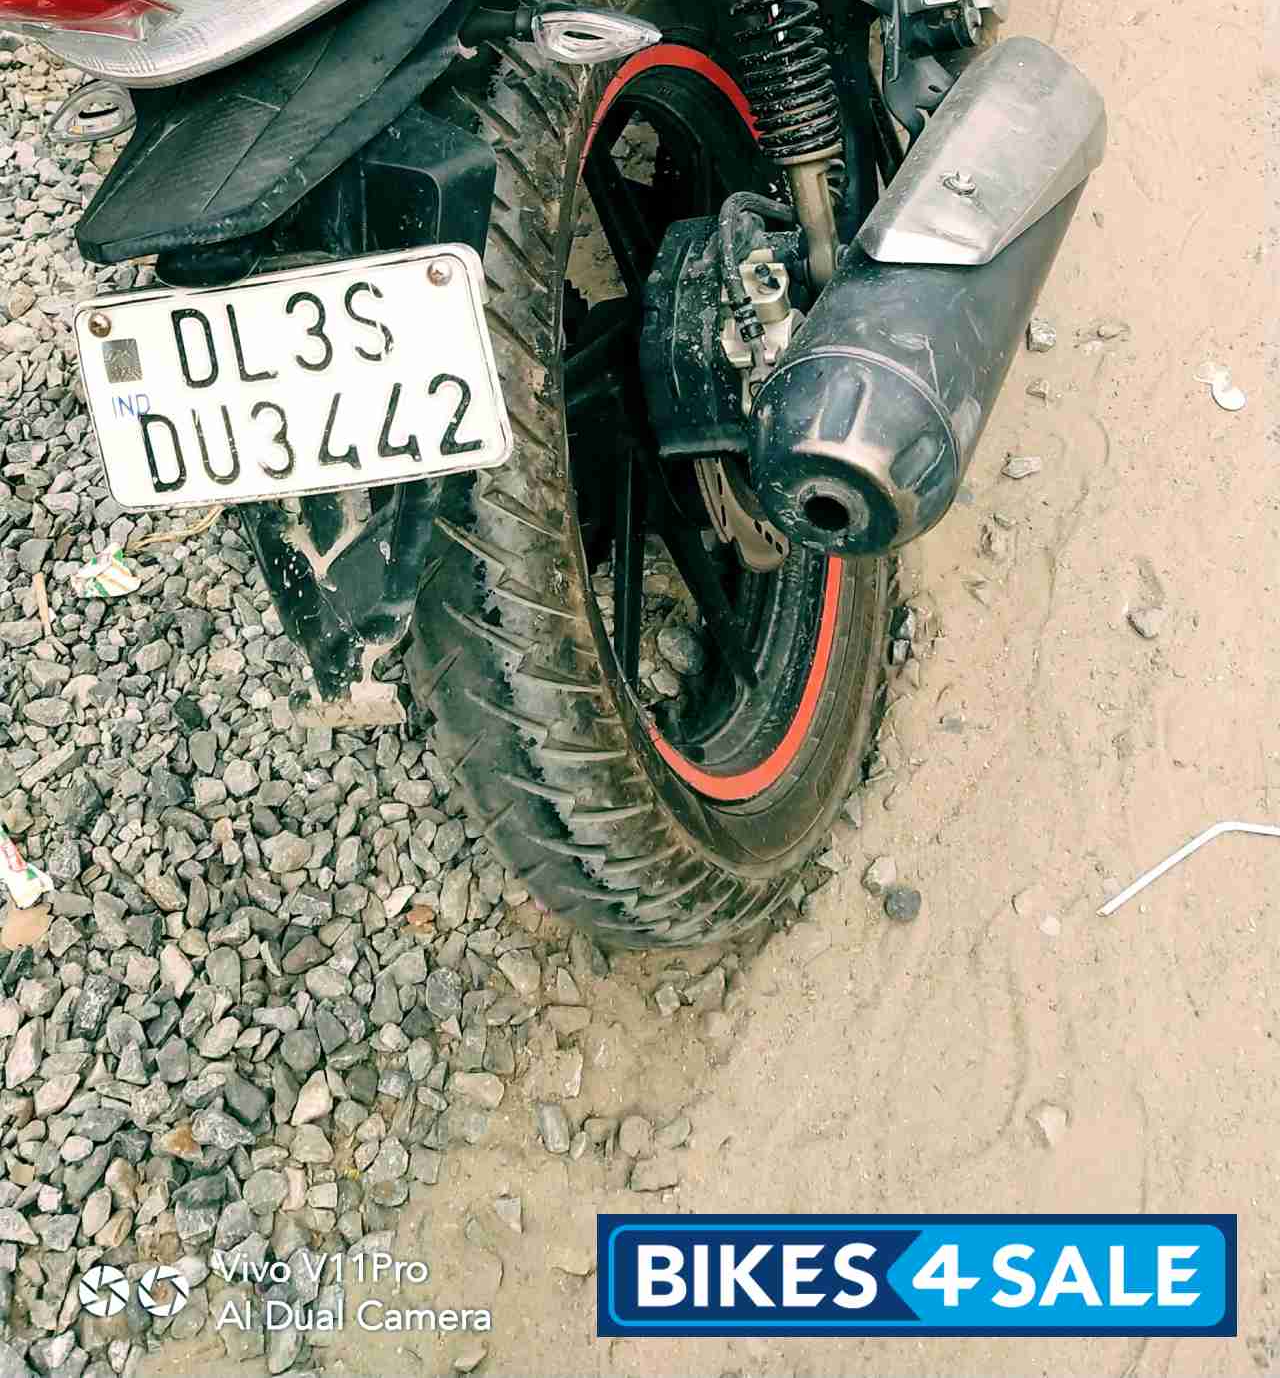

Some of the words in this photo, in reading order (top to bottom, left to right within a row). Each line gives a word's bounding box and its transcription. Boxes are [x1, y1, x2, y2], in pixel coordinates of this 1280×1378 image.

[171, 281, 395, 388] DL3S
[111, 393, 151, 418] IND
[140, 373, 484, 493] DU3442
